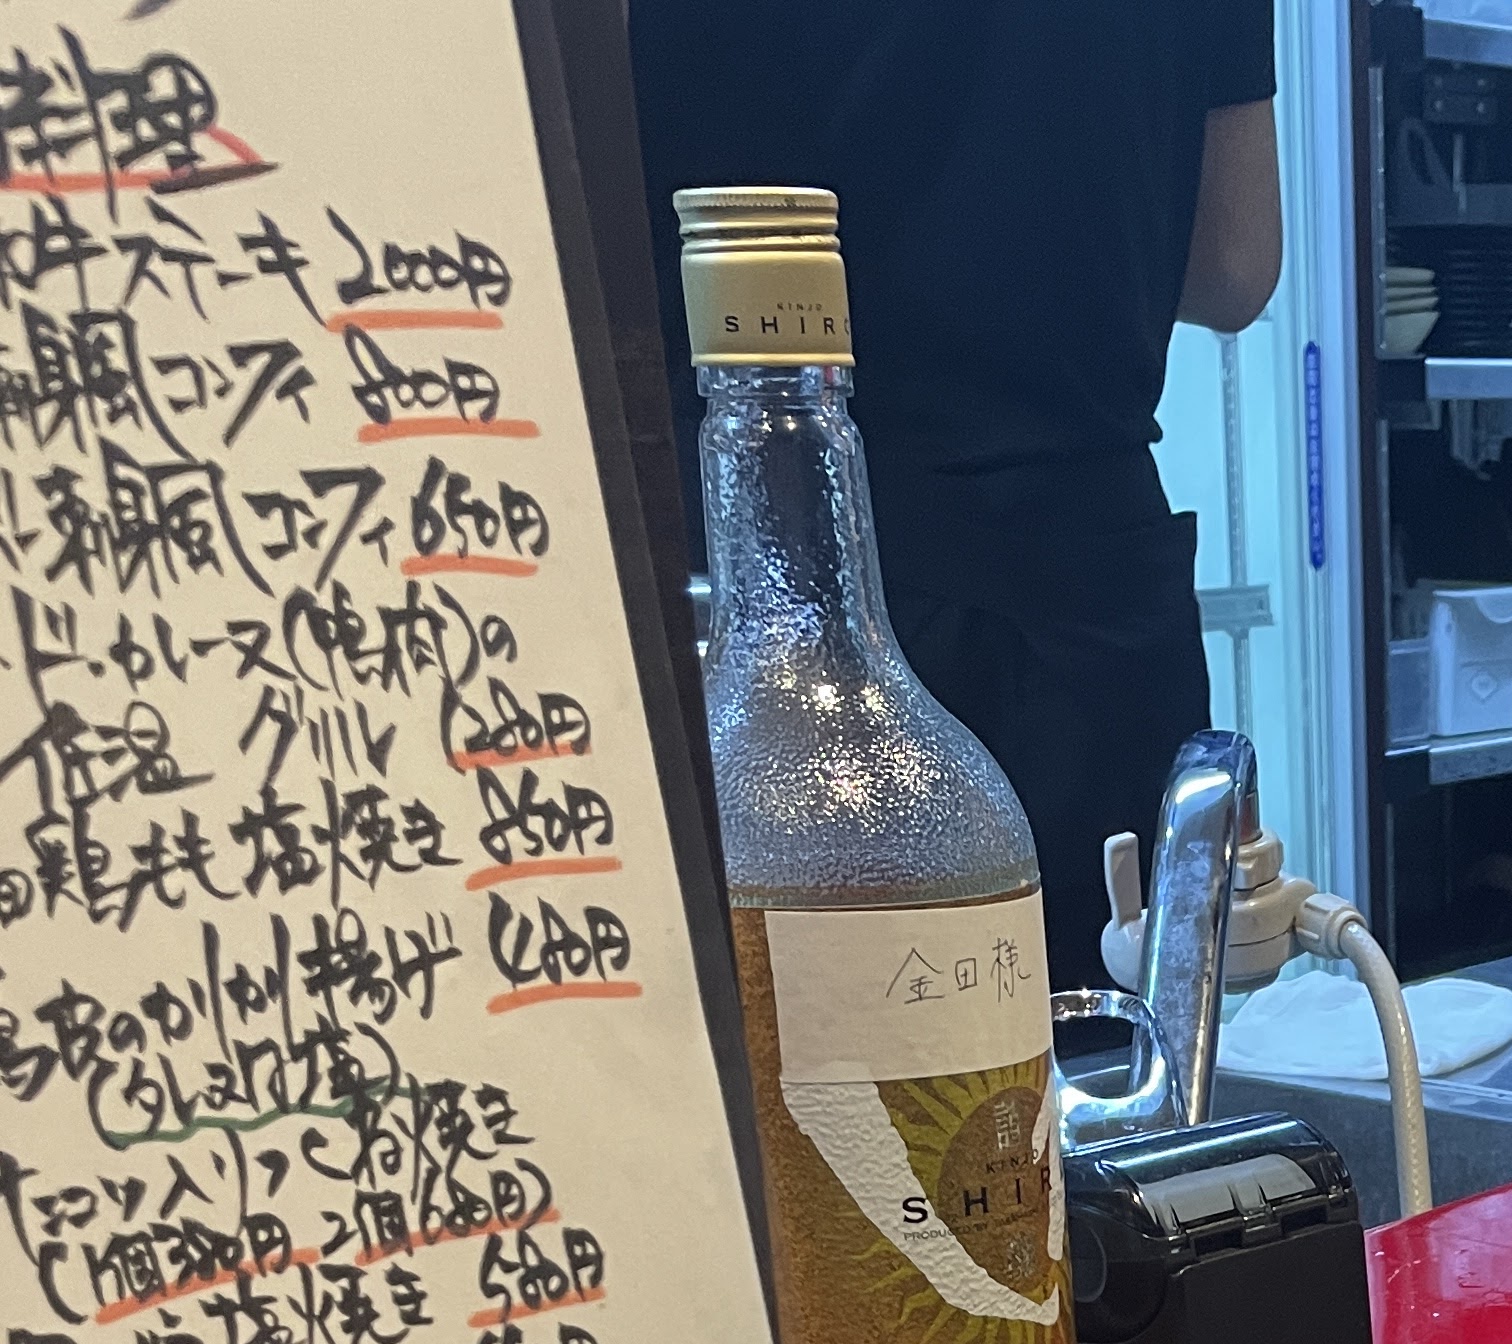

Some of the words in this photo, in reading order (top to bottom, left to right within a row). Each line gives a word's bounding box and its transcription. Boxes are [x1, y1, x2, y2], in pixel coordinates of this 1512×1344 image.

[412, 455, 548, 560] 650円
[886, 938, 1032, 1004] 金田様
